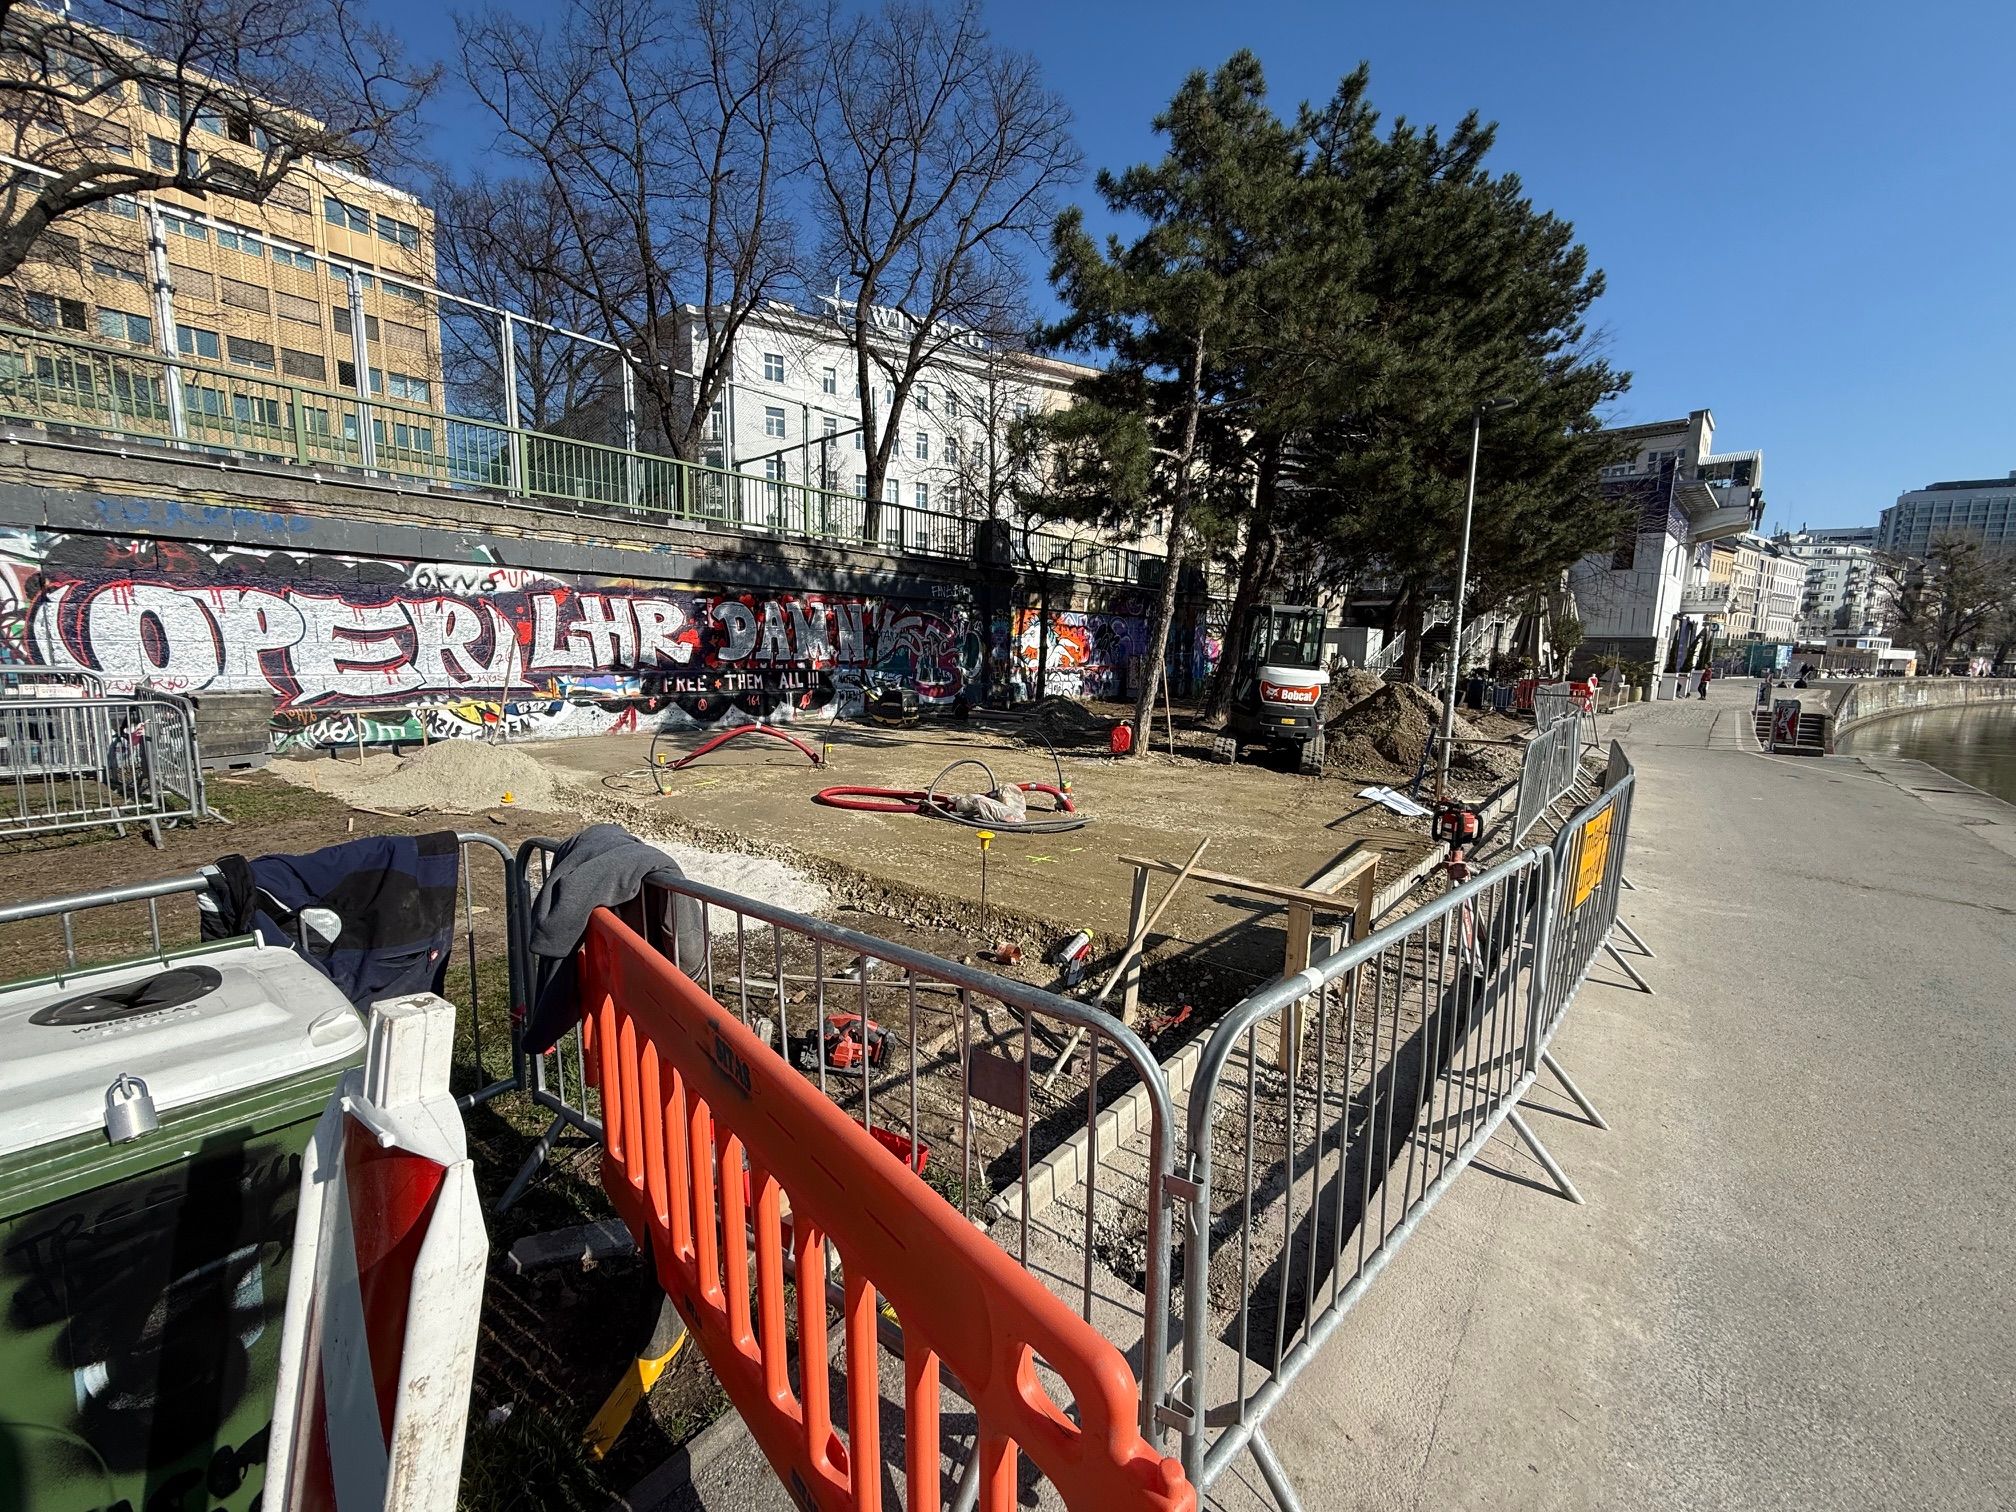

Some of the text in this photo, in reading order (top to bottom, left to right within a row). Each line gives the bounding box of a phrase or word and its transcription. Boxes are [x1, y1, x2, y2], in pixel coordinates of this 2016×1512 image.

[72, 579, 867, 712] OPER LHR DAMN
[661, 674, 708, 693] FREE
[723, 673, 764, 691] THEM
[779, 672, 804, 690] ALL
[1281, 689, 1312, 702] Bobcat
